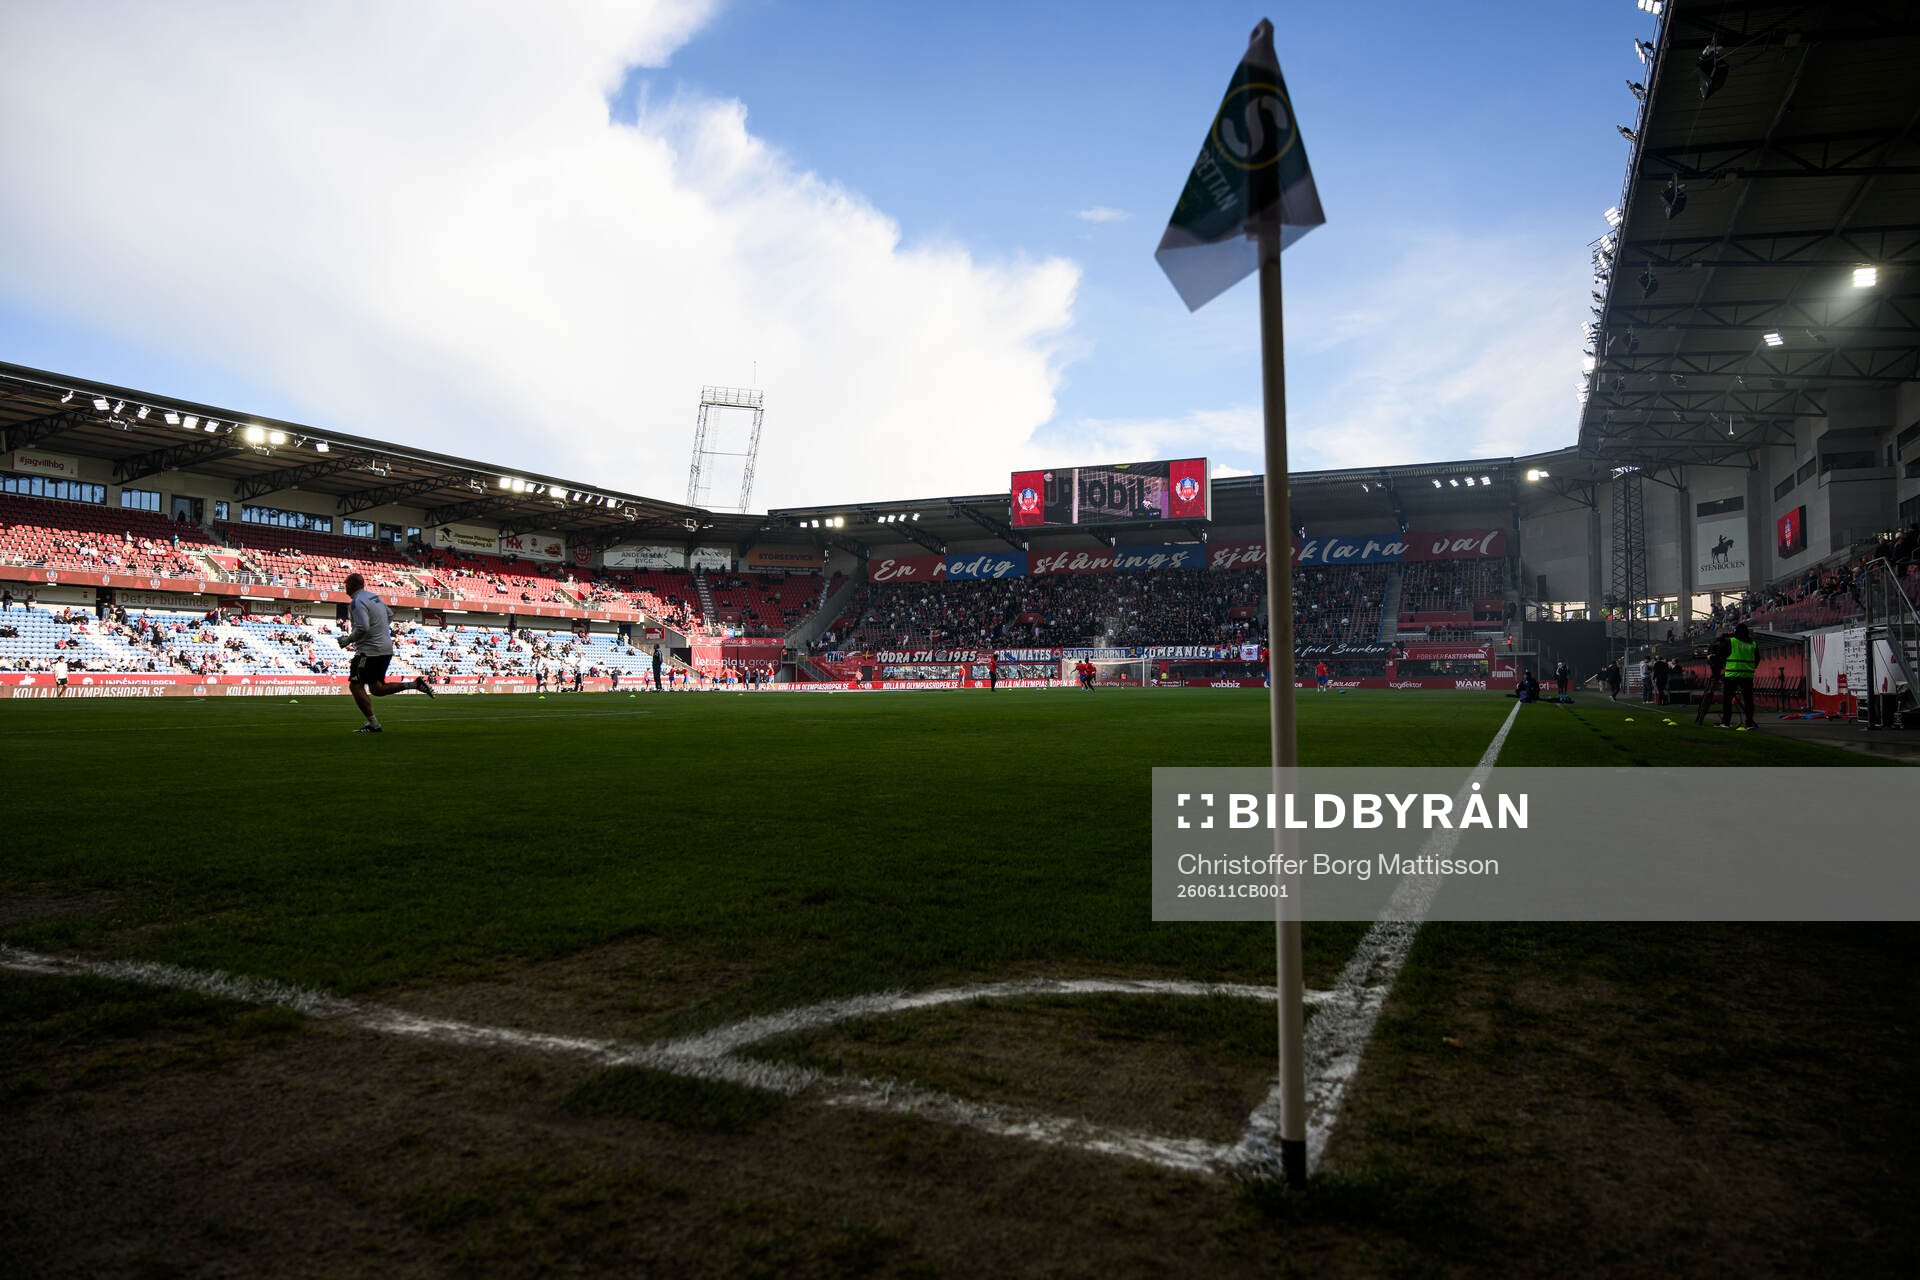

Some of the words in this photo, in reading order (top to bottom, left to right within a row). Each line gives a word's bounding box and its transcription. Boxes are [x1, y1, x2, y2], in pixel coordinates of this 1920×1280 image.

[873, 559, 917, 581] En
[932, 554, 1016, 581] redig
[1033, 550, 1191, 576] skånings
[1432, 531, 1499, 555] val
[876, 651, 910, 663] SÖDRA
[948, 650, 977, 662] 1985
